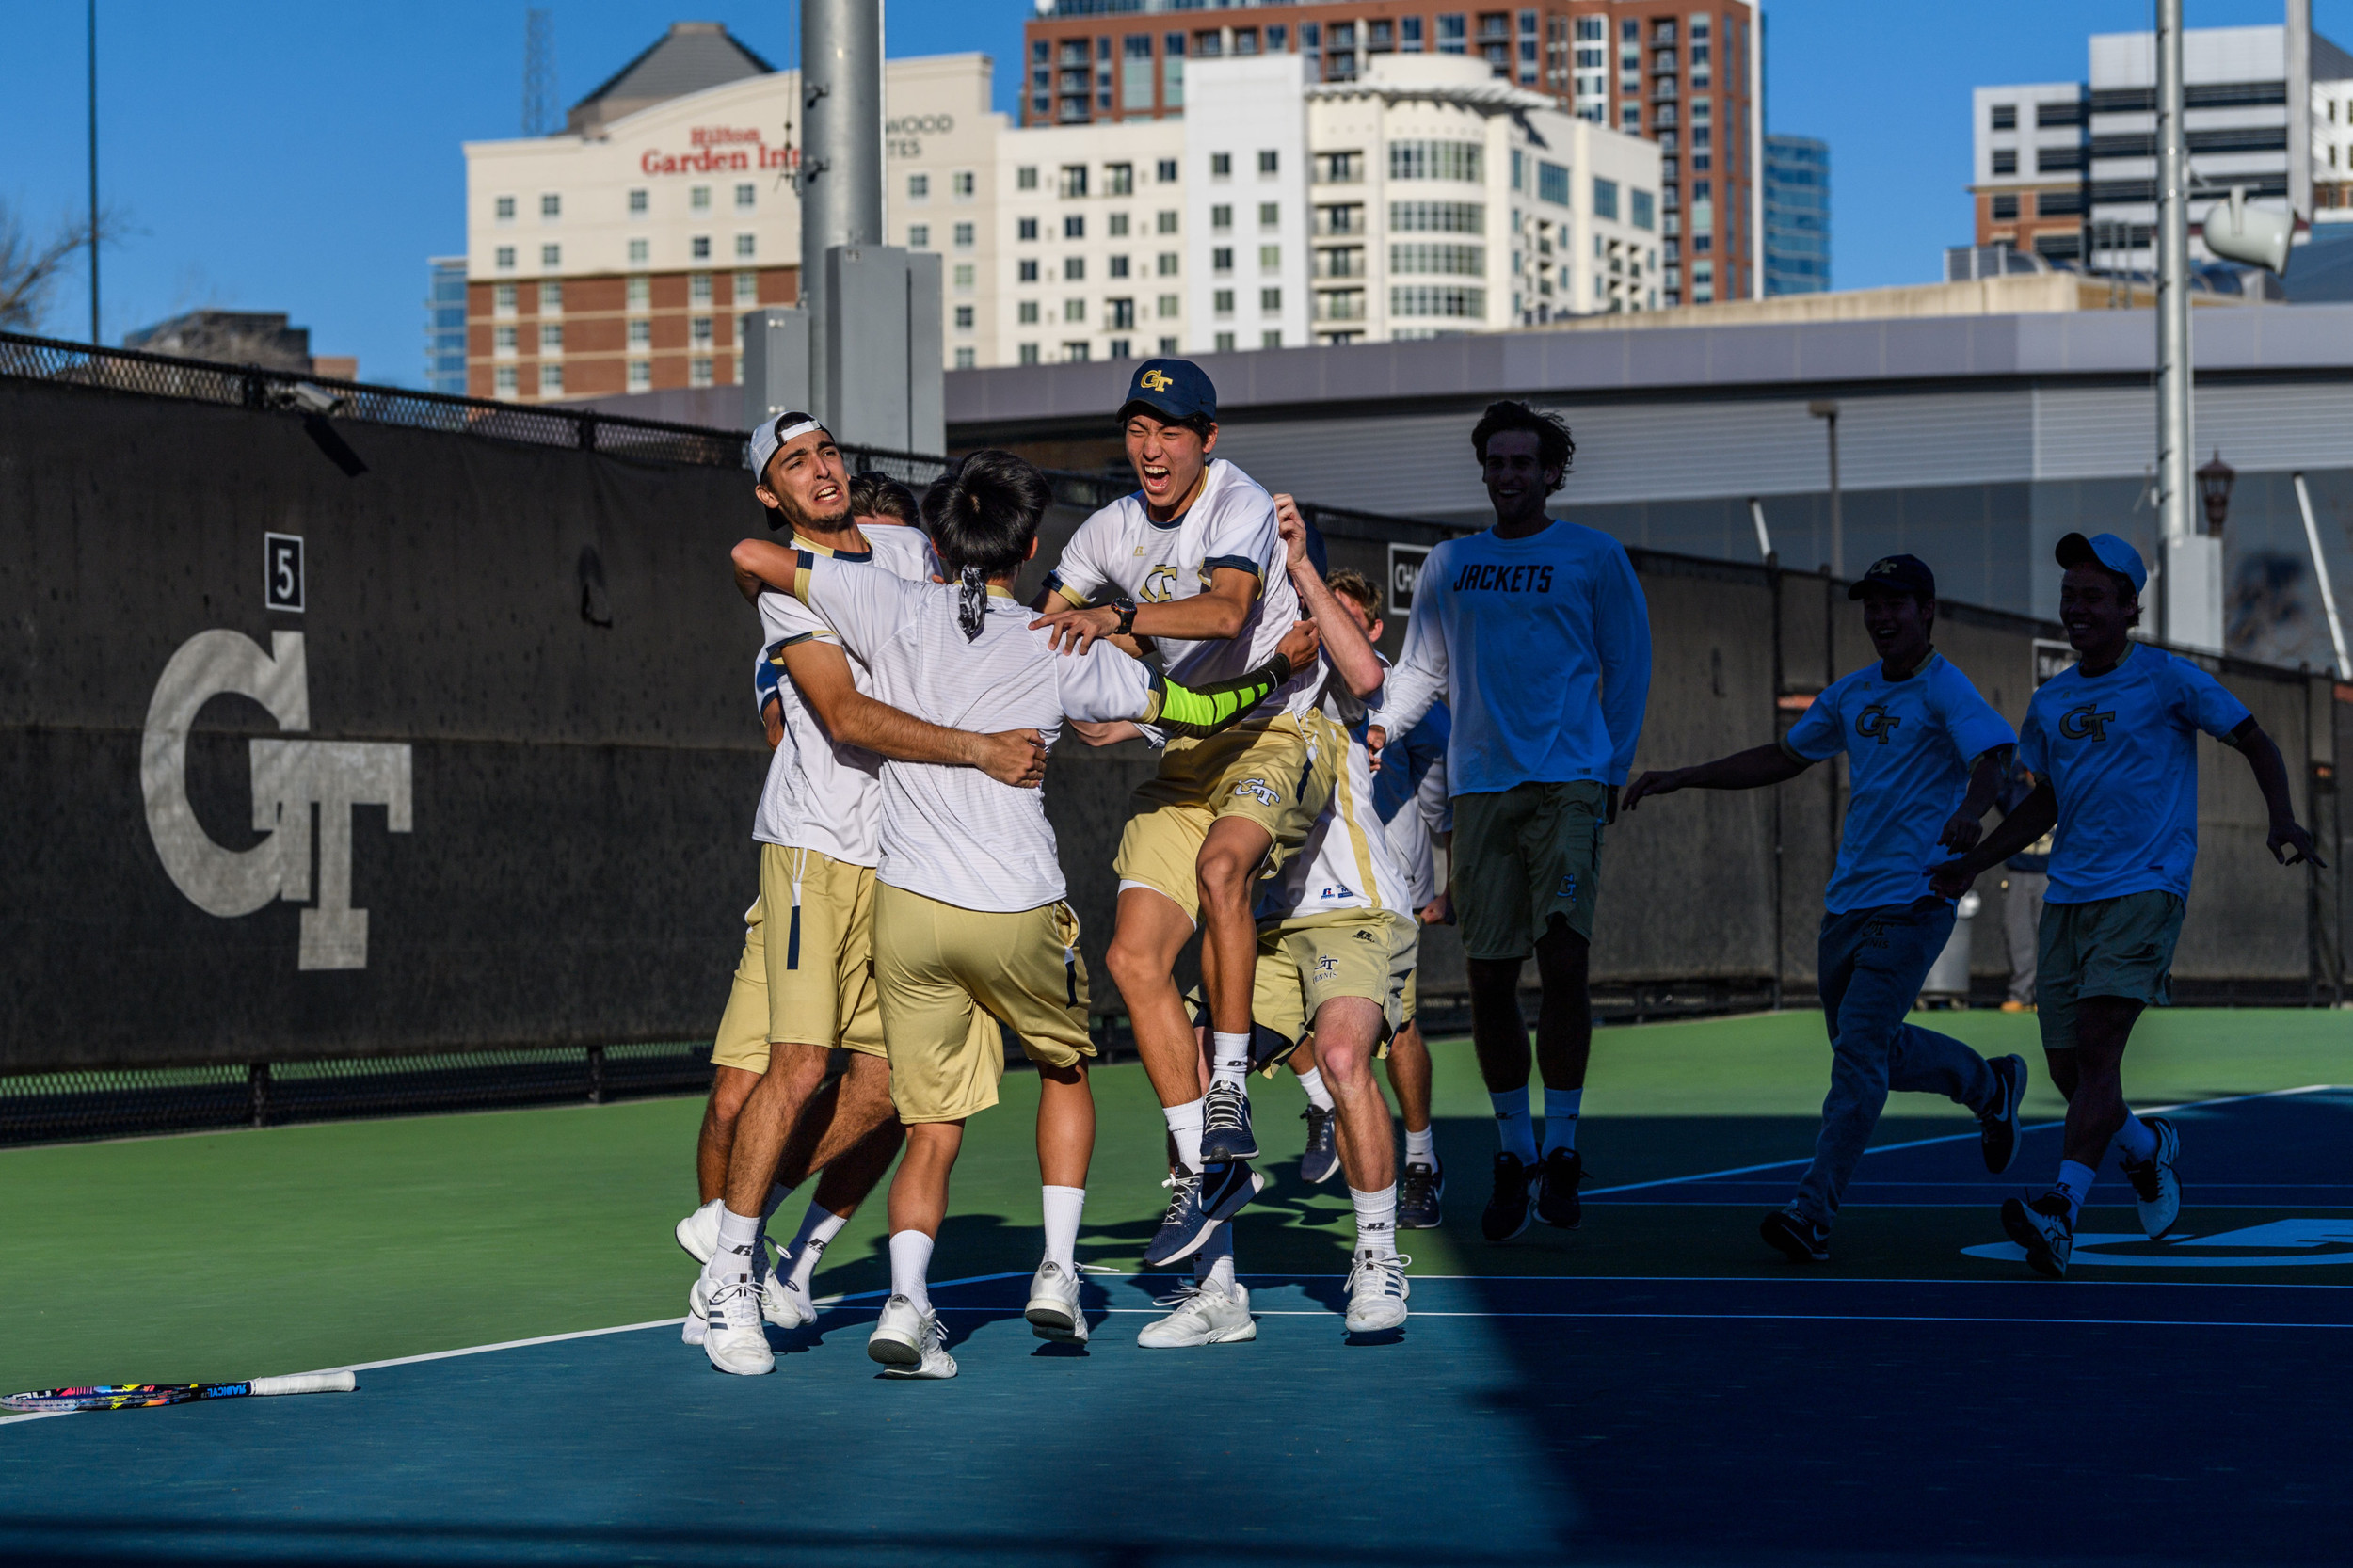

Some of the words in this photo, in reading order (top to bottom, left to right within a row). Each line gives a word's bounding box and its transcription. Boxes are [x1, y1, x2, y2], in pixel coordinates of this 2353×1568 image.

[690, 126, 760, 146] Hilton
[641, 146, 749, 175] Garden
[1140, 370, 1174, 392] GT
[275, 548, 294, 600] 5
[1453, 565, 1554, 593] JACKETS
[1855, 704, 1900, 744] GT
[2059, 704, 2115, 742] GT
[140, 629, 412, 970] GT
